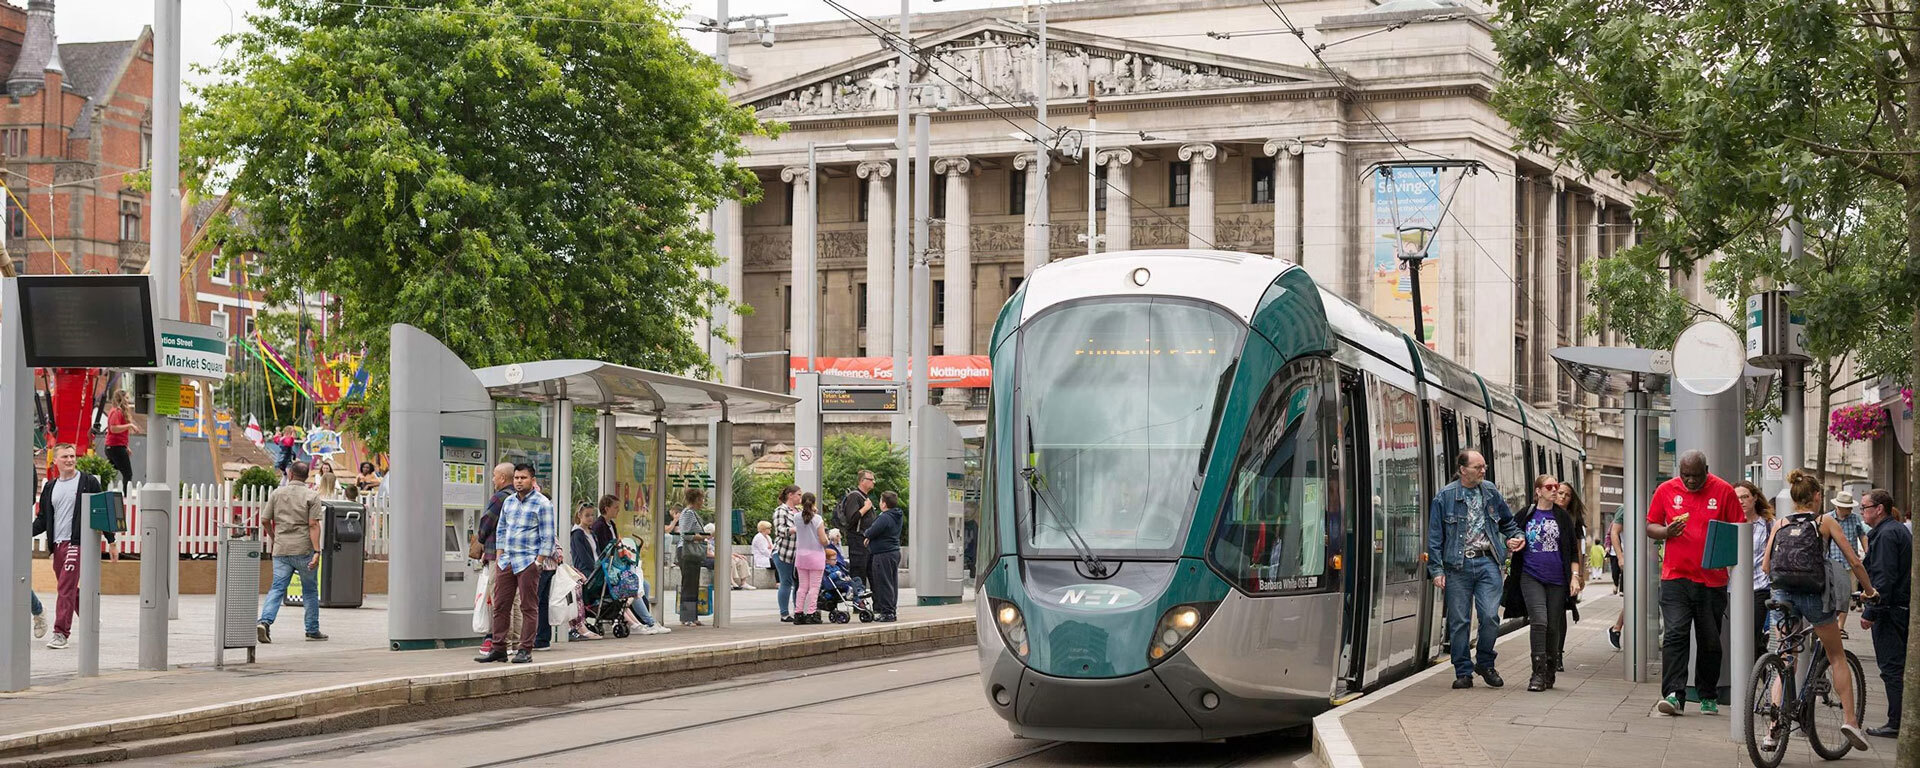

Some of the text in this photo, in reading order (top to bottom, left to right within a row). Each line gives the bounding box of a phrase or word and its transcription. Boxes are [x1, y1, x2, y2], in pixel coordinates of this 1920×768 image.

[1378, 179, 1437, 195] Savings?
[176, 338, 193, 347] Street
[166, 354, 223, 374] Market Square
[873, 368, 893, 379] Fos
[930, 367, 989, 379] Nottingham
[1259, 579, 1282, 591] Barbara
[1283, 577, 1298, 589] White
[1058, 589, 1129, 605] NET
